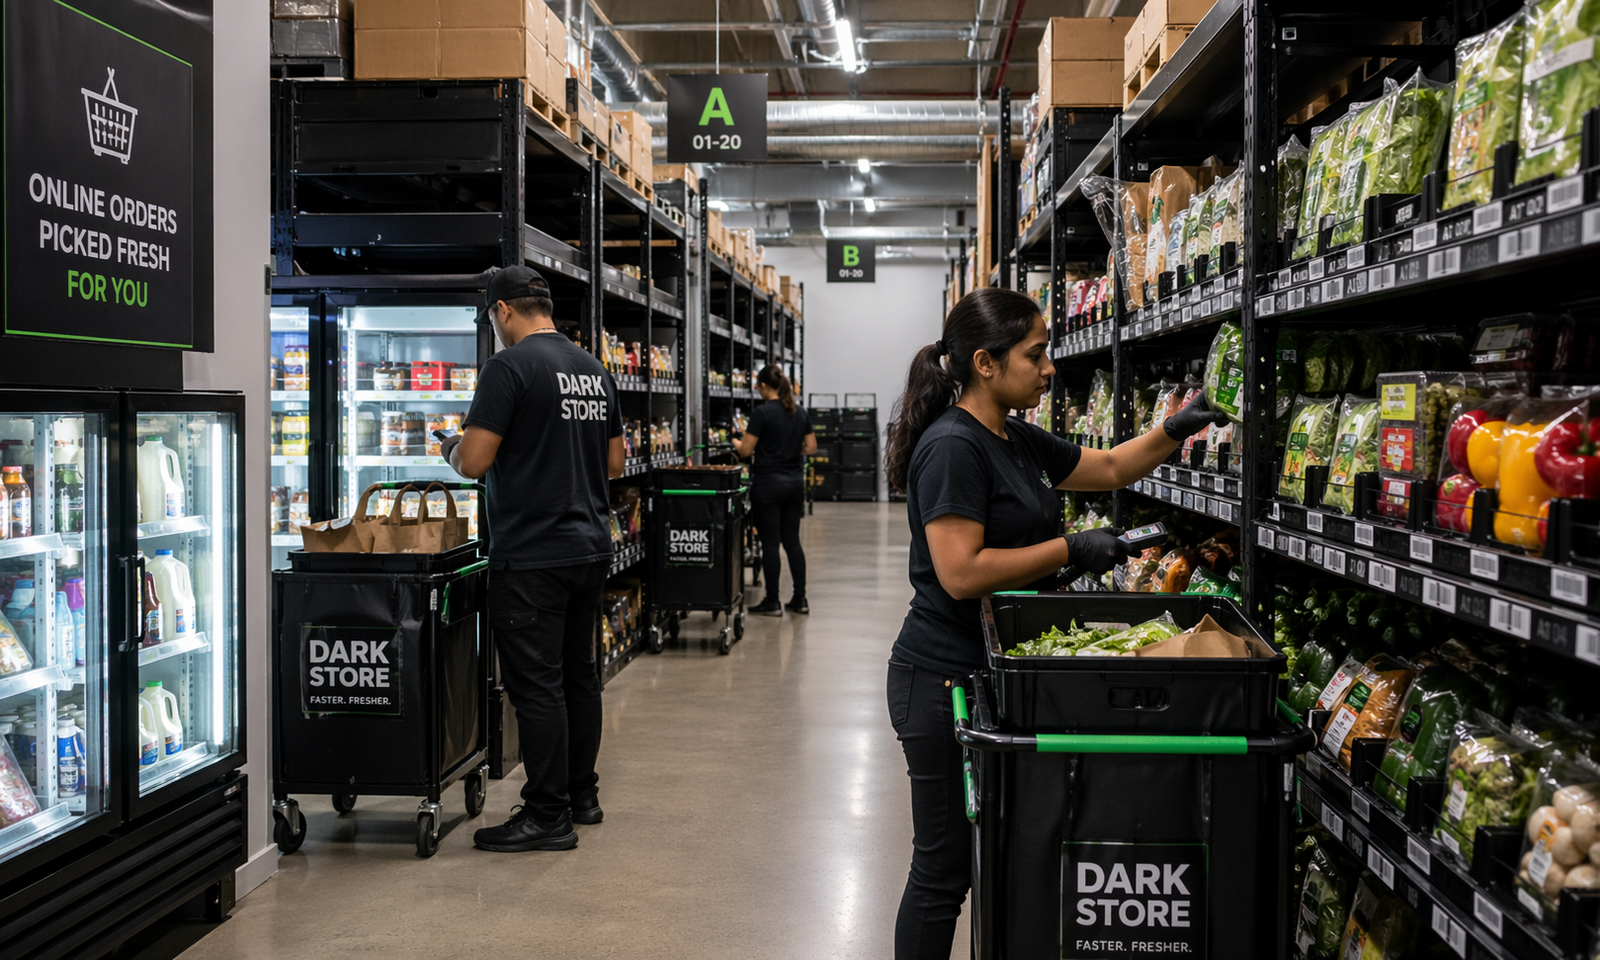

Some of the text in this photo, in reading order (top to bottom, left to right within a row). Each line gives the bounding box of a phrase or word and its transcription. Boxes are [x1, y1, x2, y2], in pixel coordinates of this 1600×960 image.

[698, 86, 735, 126] A
[692, 134, 742, 150] 01-20
[29, 172, 178, 235] ONLINE ORDERS
[39, 219, 170, 272] PICKED FRESH
[843, 244, 860, 267] B
[838, 268, 864, 278] 01-20
[67, 269, 148, 308] FOR YOU
[556, 371, 607, 397] DARK
[560, 398, 608, 421] STORE
[669, 529, 709, 543] DARK
[669, 542, 710, 554] STORE
[309, 639, 390, 664] DARK
[309, 666, 390, 688] STORE
[309, 695, 392, 705] FASTER. FRESHER.
[1077, 861, 1191, 896] DARK
[1075, 897, 1191, 928] STORE
[1076, 939, 1193, 953] FASTER. FRESHER.
